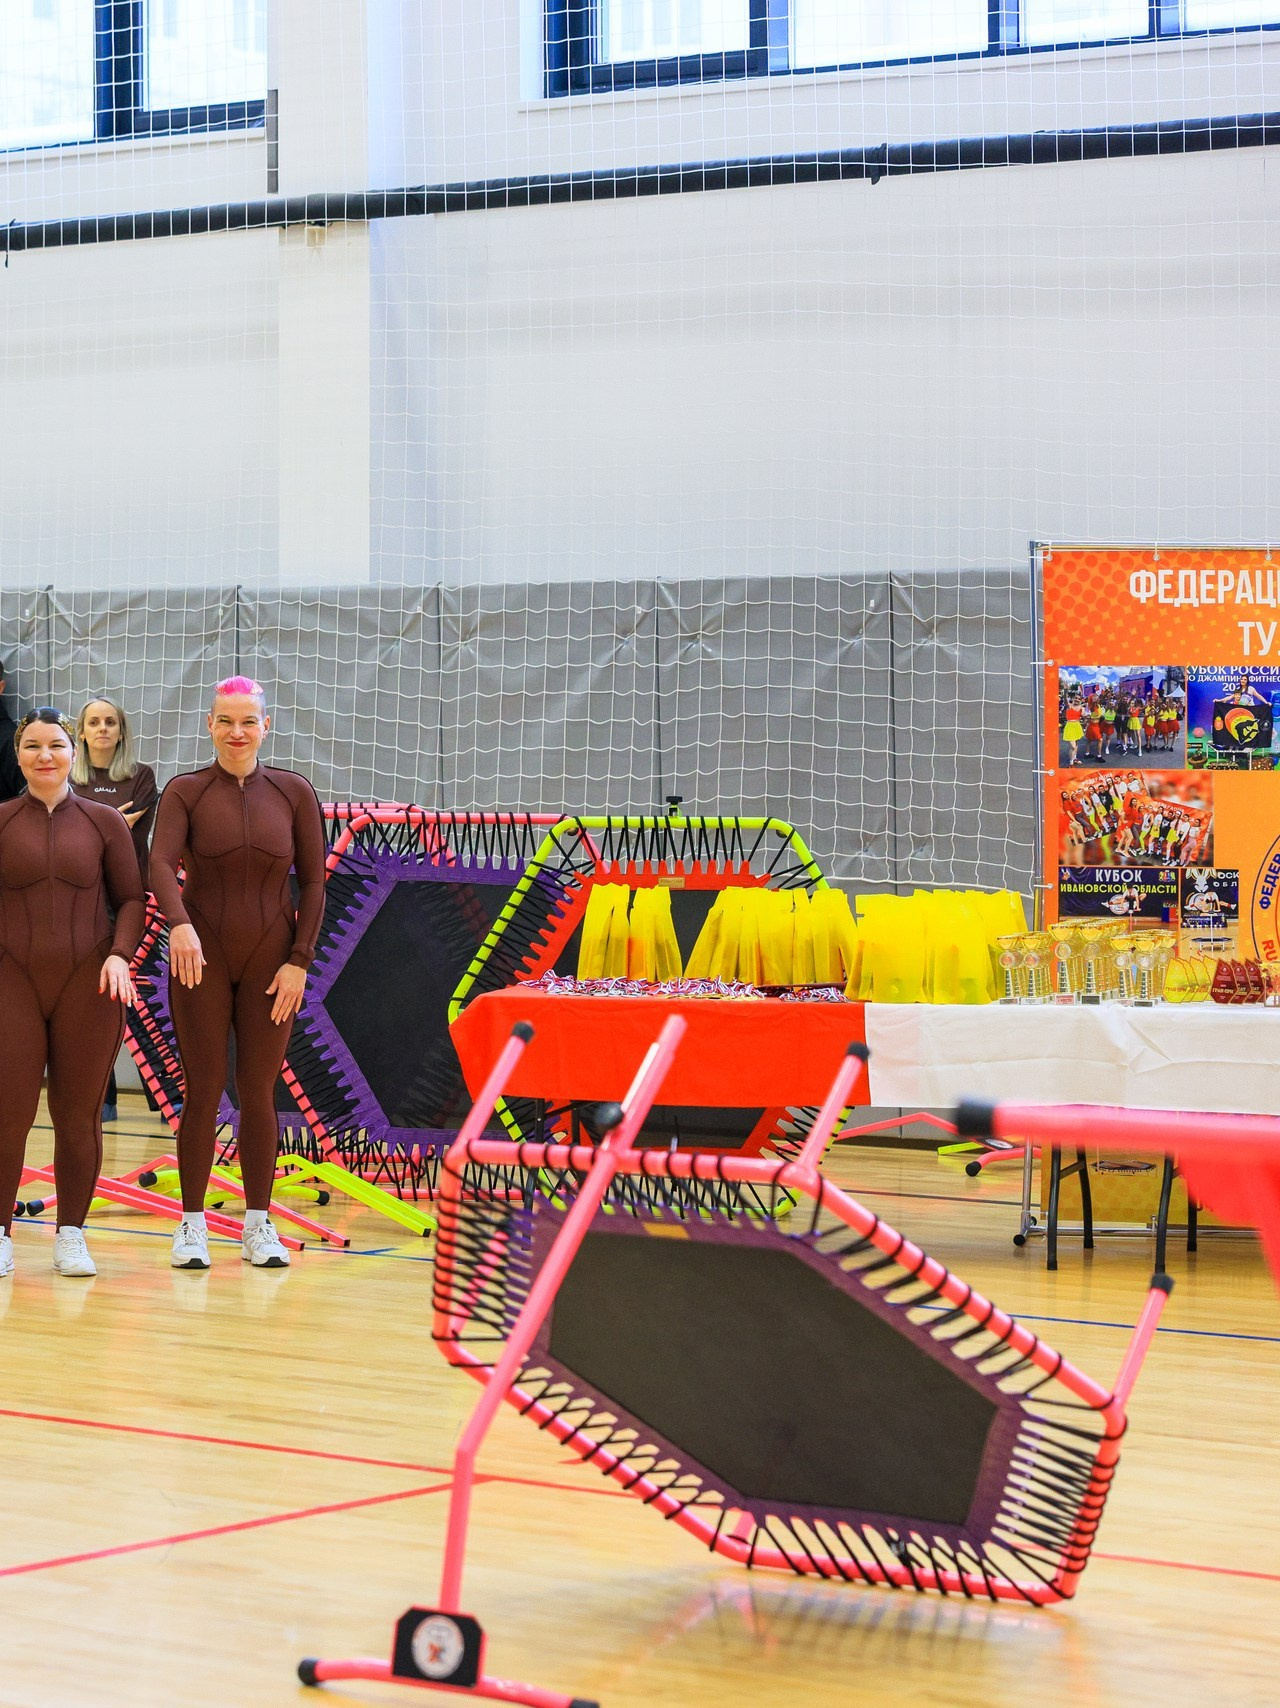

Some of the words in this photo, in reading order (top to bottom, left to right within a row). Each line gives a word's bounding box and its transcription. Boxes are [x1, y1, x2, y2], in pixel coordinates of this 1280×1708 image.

[1129, 569, 1280, 607] ФЕДЕРАЦ
[1237, 621, 1280, 656] ТУ
[1197, 674, 1241, 683] ДЖАМПИН
[1095, 868, 1143, 883] КУБОК
[1060, 883, 1128, 894] ИВАНОВСКОЙ
